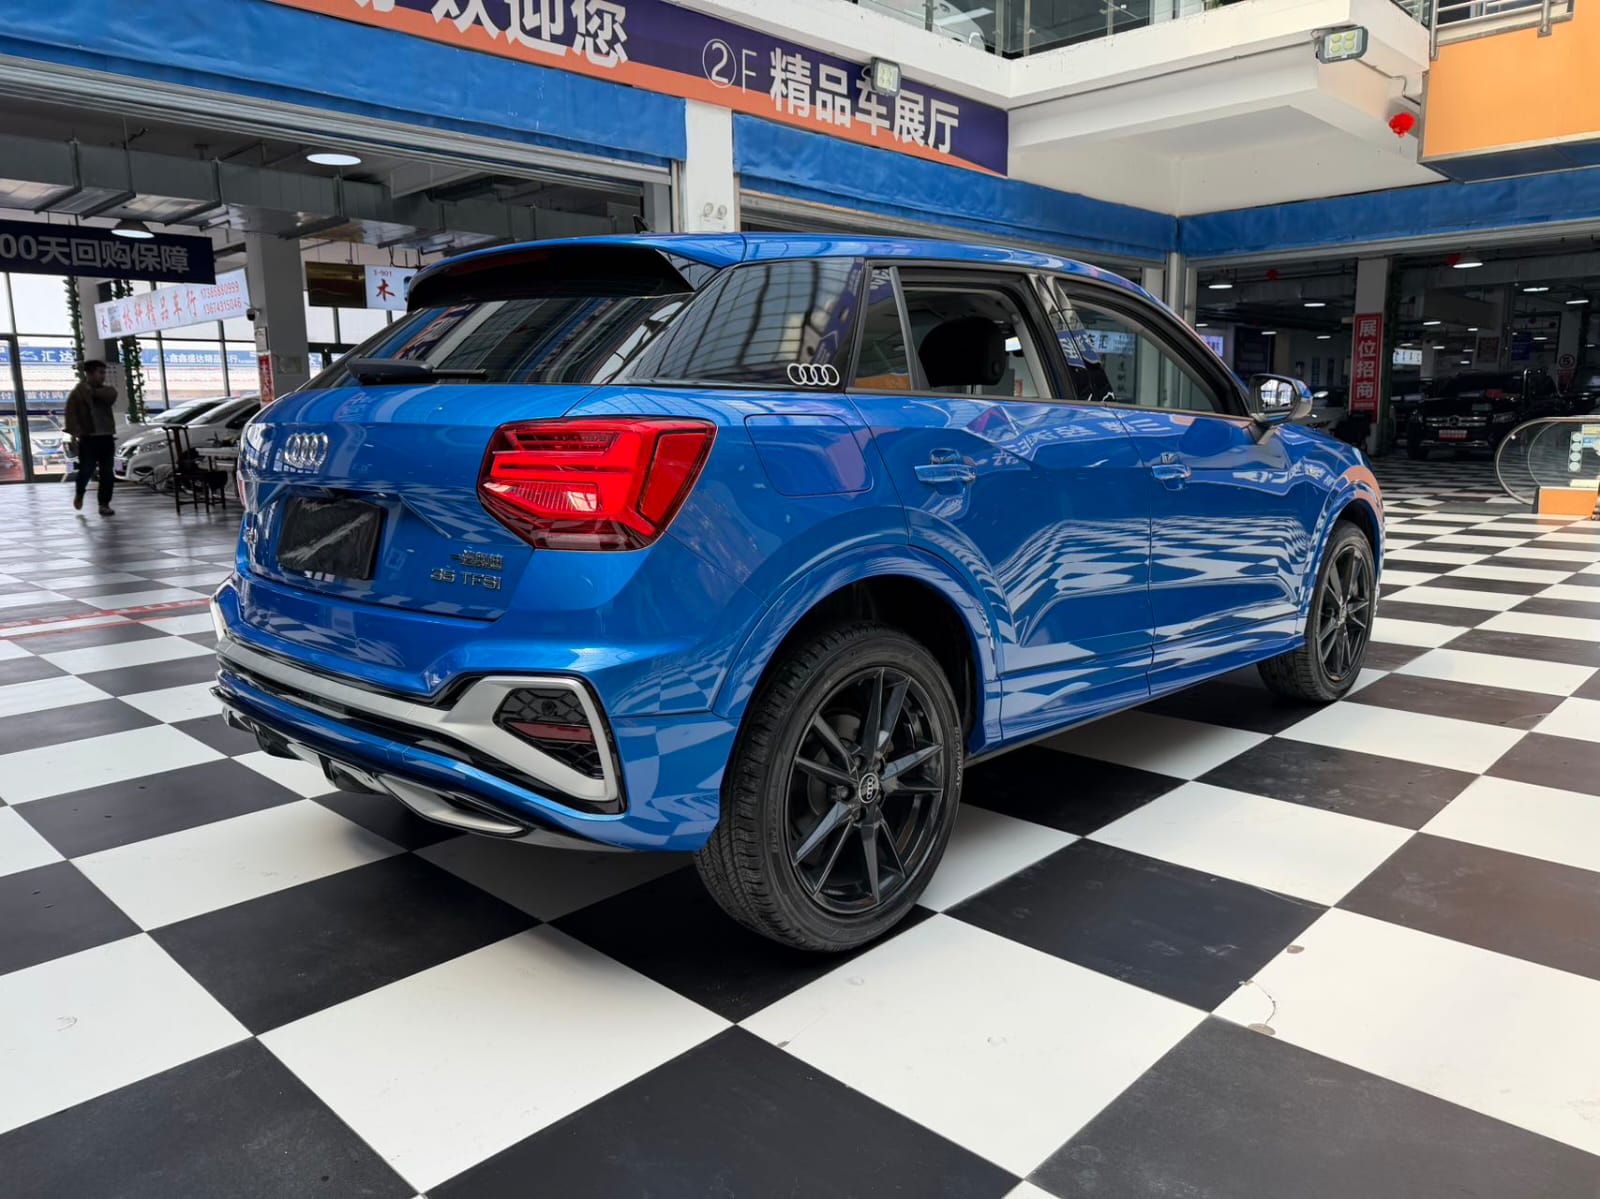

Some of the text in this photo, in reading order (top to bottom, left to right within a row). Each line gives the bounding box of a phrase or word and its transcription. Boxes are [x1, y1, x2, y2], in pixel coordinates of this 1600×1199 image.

[354, 0, 628, 69] 欢迎您
[769, 47, 960, 154] 精品车展厅
[1356, 319, 1377, 399] 展位招商
[430, 568, 502, 590] 35 TFSI
